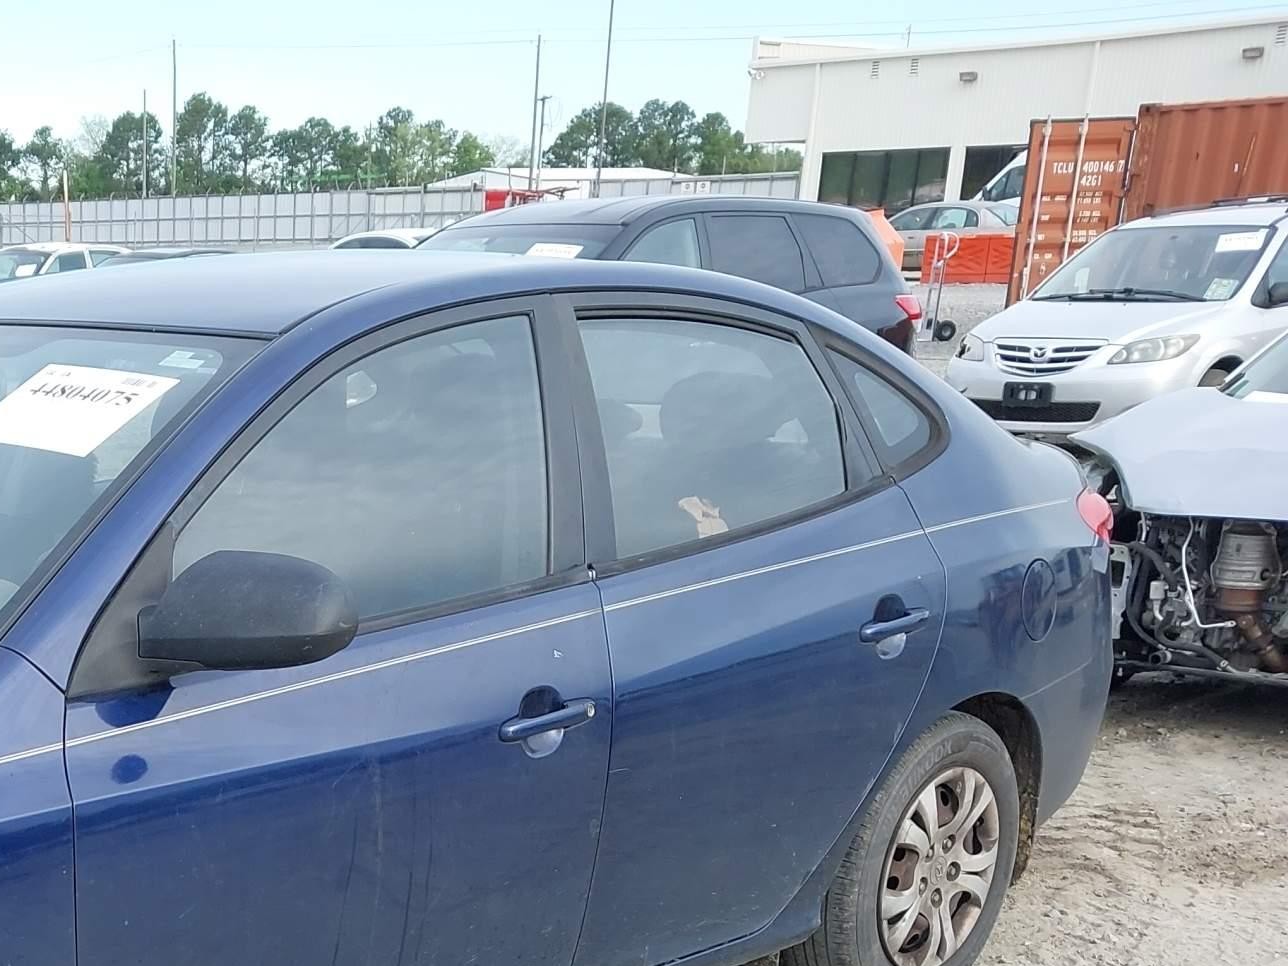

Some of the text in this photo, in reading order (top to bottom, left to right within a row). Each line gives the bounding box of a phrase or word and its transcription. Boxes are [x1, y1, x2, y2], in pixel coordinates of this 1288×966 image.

[1052, 161, 1074, 174] TCLU
[1082, 160, 1115, 174] 400146
[1080, 174, 1102, 187] 42G1
[30, 382, 140, 406] 44804075
